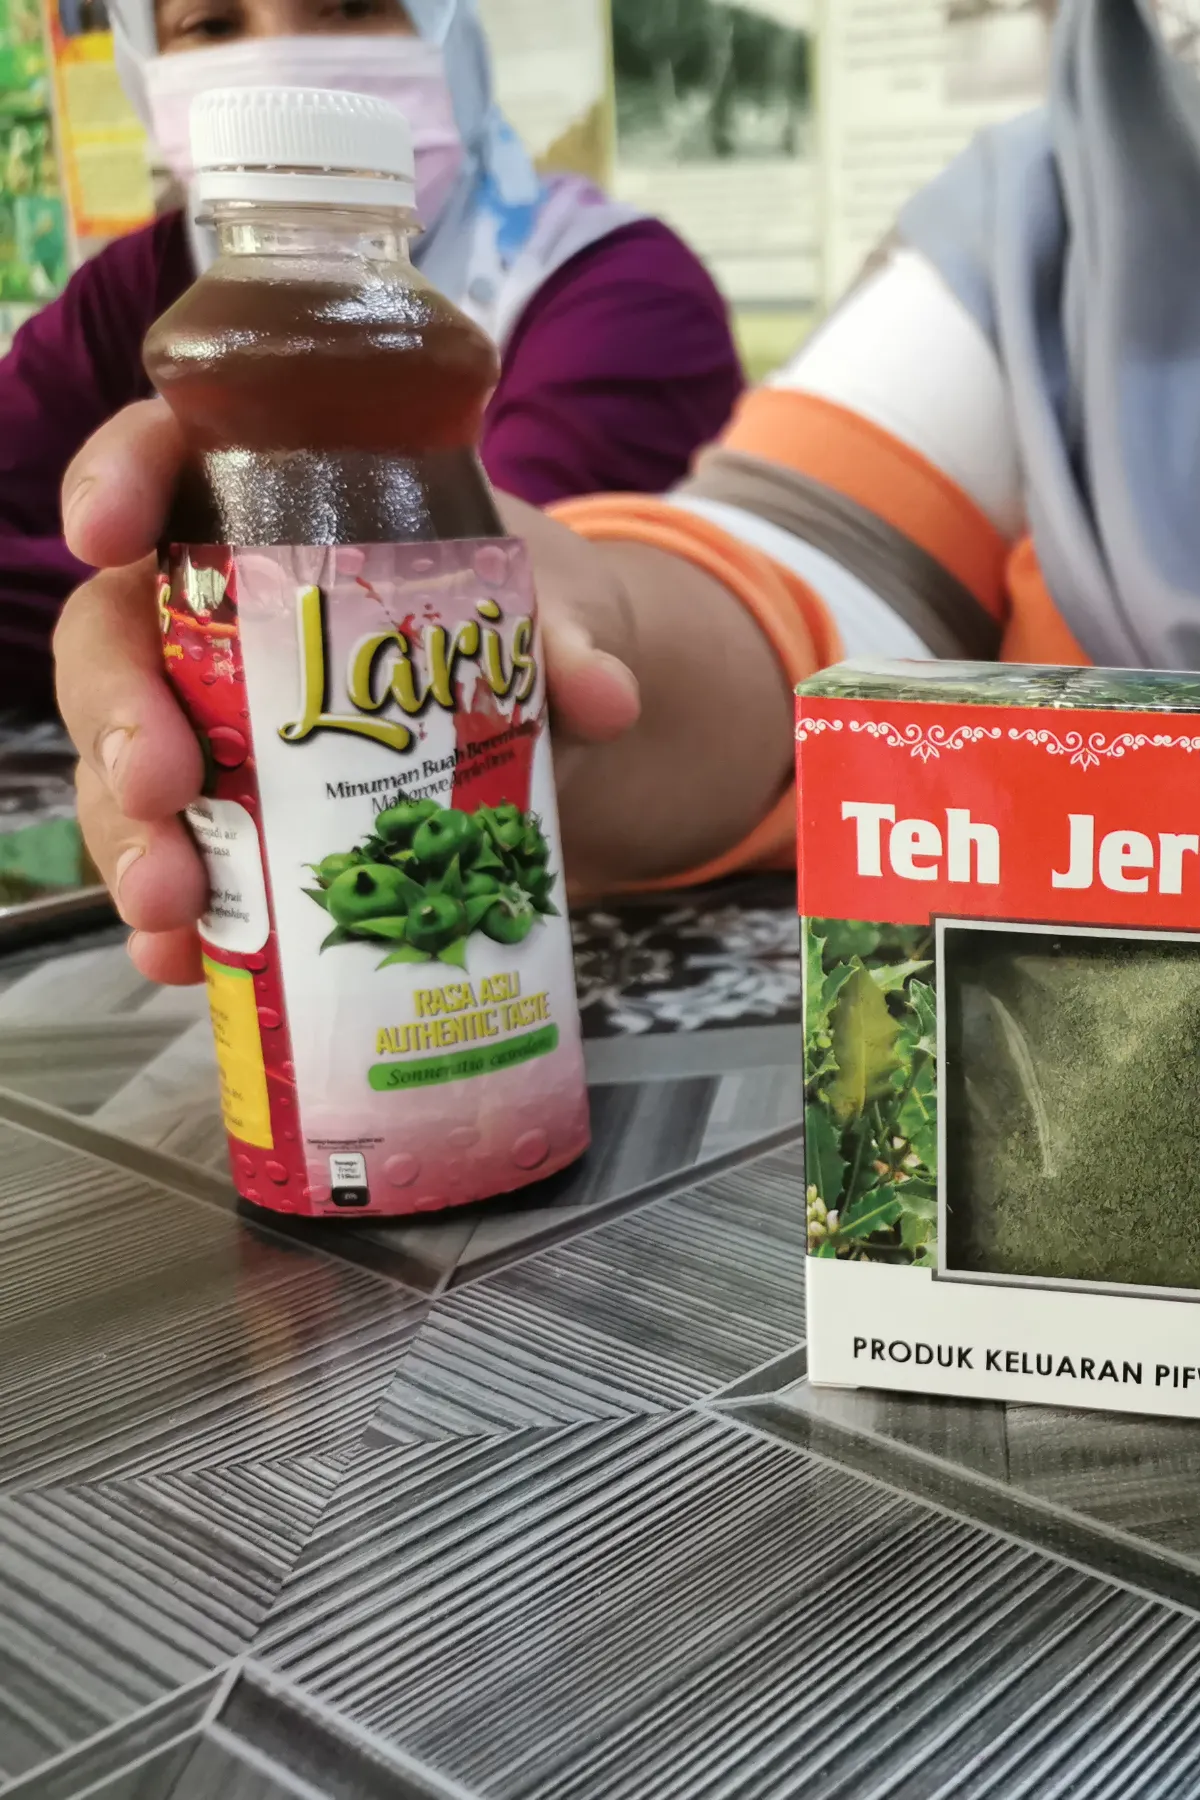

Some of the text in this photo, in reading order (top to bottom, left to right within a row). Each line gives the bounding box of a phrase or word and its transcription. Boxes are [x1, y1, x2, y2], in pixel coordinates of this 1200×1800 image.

[278, 584, 537, 756] Laris
[325, 766, 431, 800] Minuman
[421, 748, 461, 778] Buah
[371, 777, 452, 815] Magrove
[841, 801, 1000, 885] Teh
[374, 992, 551, 1055] AUTHENTIC TASTE
[413, 983, 478, 1017] RASA
[852, 1336, 975, 1370] PRODUK
[984, 1349, 1143, 1385] KELUARAN
